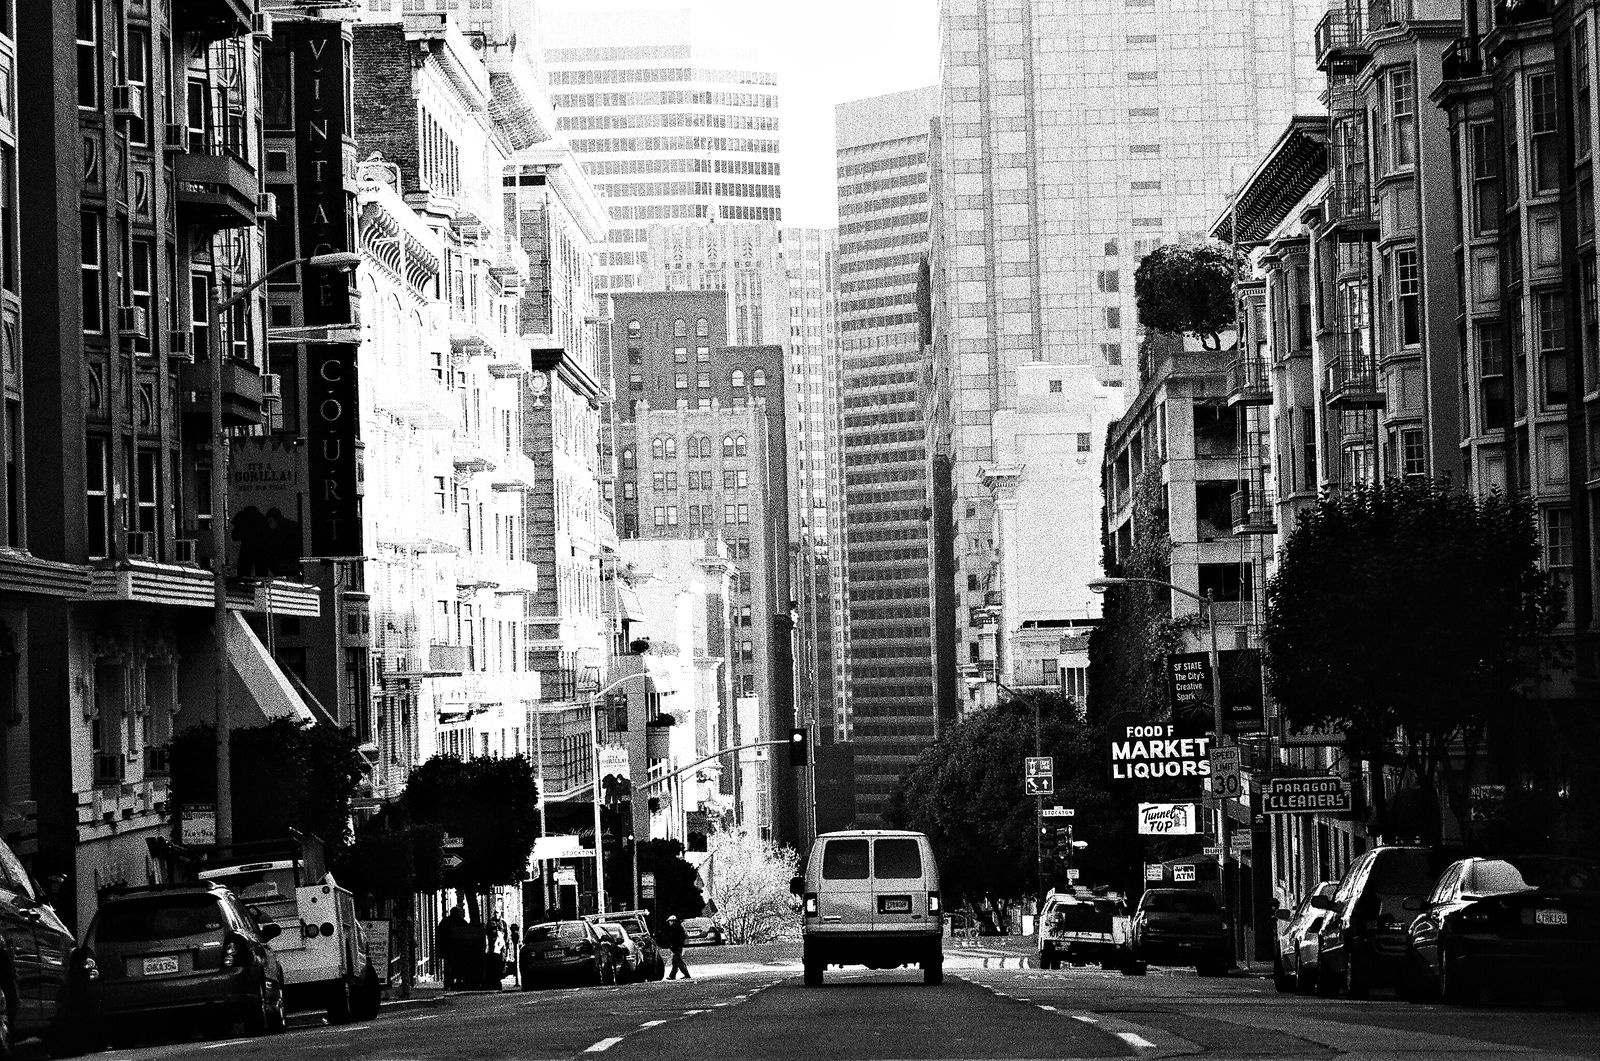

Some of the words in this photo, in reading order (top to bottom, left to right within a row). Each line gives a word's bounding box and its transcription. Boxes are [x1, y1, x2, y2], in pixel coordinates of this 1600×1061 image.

[319, 359, 343, 540] COURT
[235, 471, 291, 482] GORILLA!
[1173, 663, 1182, 671] SF
[1183, 661, 1202, 670] STATE
[1175, 673, 1187, 681] The
[1187, 671, 1205, 681] City's
[1176, 682, 1202, 691] Creative
[1177, 692, 1196, 702] Spark
[1126, 725, 1163, 738] FOOD
[1111, 738, 1210, 760] MARKET
[1211, 750, 1235, 760] SPEED
[1113, 760, 1211, 779] LIQUORS
[1215, 763, 1234, 771] LIMIT
[1215, 775, 1238, 794] 30
[1276, 782, 1337, 793] PARAGON
[1270, 794, 1344, 808] CLEANERS
[182, 811, 192, 819] NO
[1142, 805, 1175, 824] Tunnel
[1149, 821, 1173, 832] TOP
[561, 849, 594, 857] STOCKTON
[1175, 872, 1194, 880] ATM
